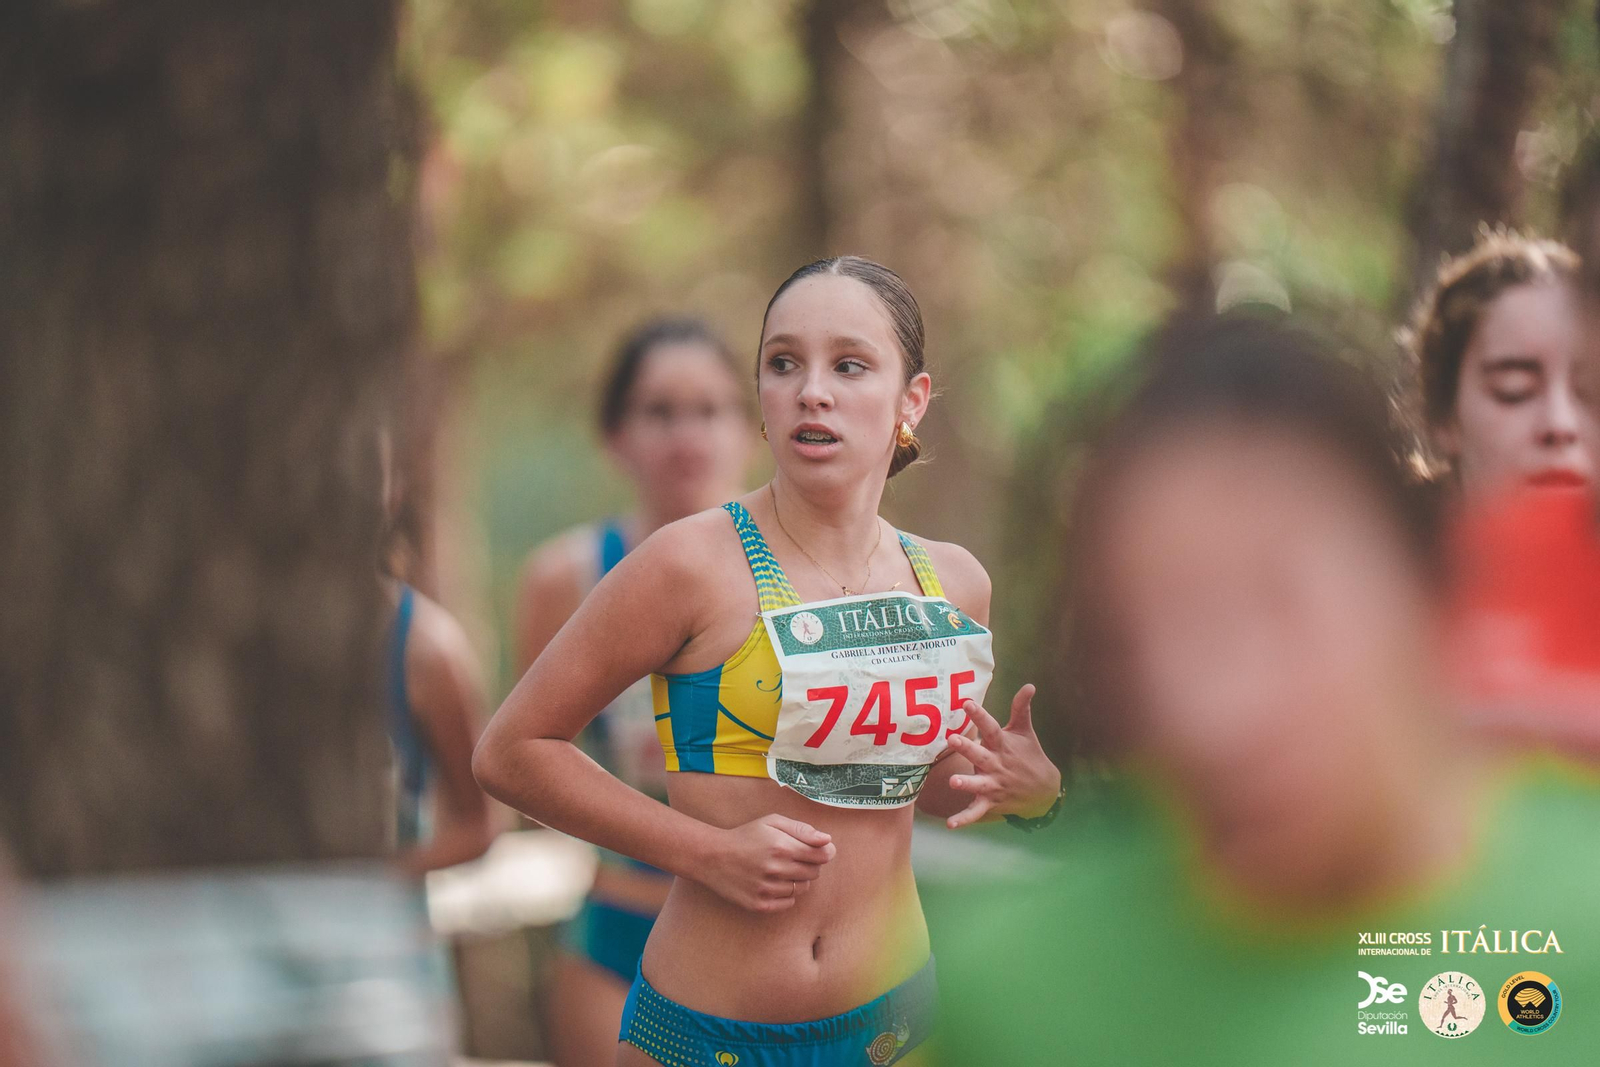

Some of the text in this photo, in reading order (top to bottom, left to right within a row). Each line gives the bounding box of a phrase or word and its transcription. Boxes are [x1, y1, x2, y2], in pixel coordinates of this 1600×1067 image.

[838, 602, 936, 633] ITÁLICA
[842, 630, 893, 640] INTERNATIONAL
[831, 638, 957, 659] GABRIELA JIMENEZ MORATO
[871, 653, 921, 665] CD CALLENCE
[803, 670, 975, 749] 7455
[818, 796, 859, 805] FEDERACIÓN
[862, 798, 898, 806] ANDALUZA
